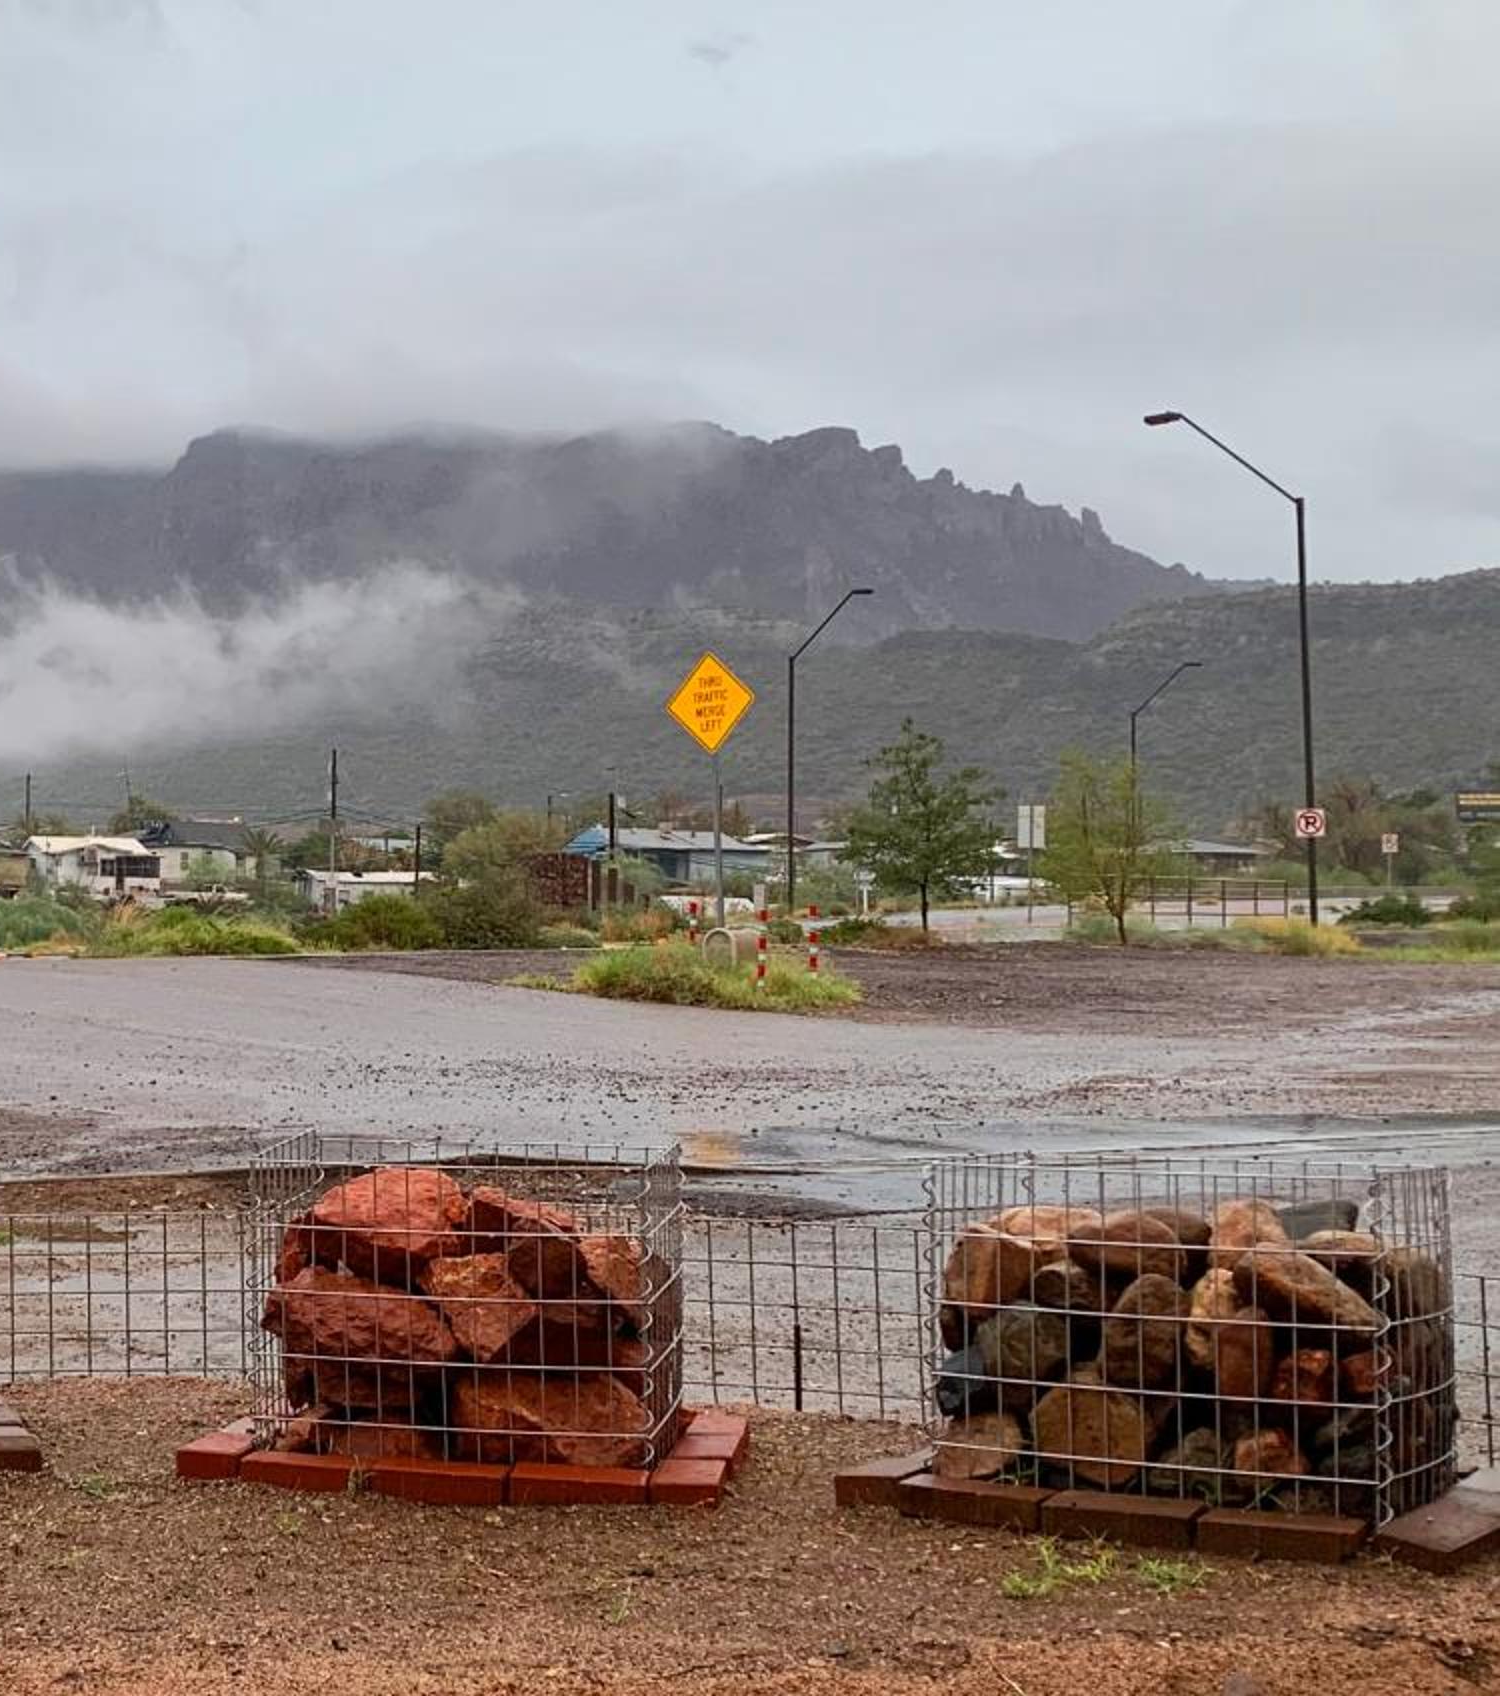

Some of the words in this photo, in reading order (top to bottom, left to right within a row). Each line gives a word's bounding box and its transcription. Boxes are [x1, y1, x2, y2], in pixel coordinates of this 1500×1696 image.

[693, 690, 728, 703] TRAFFIC
[695, 705, 725, 718] MERGE
[700, 720, 722, 732] LEFT
